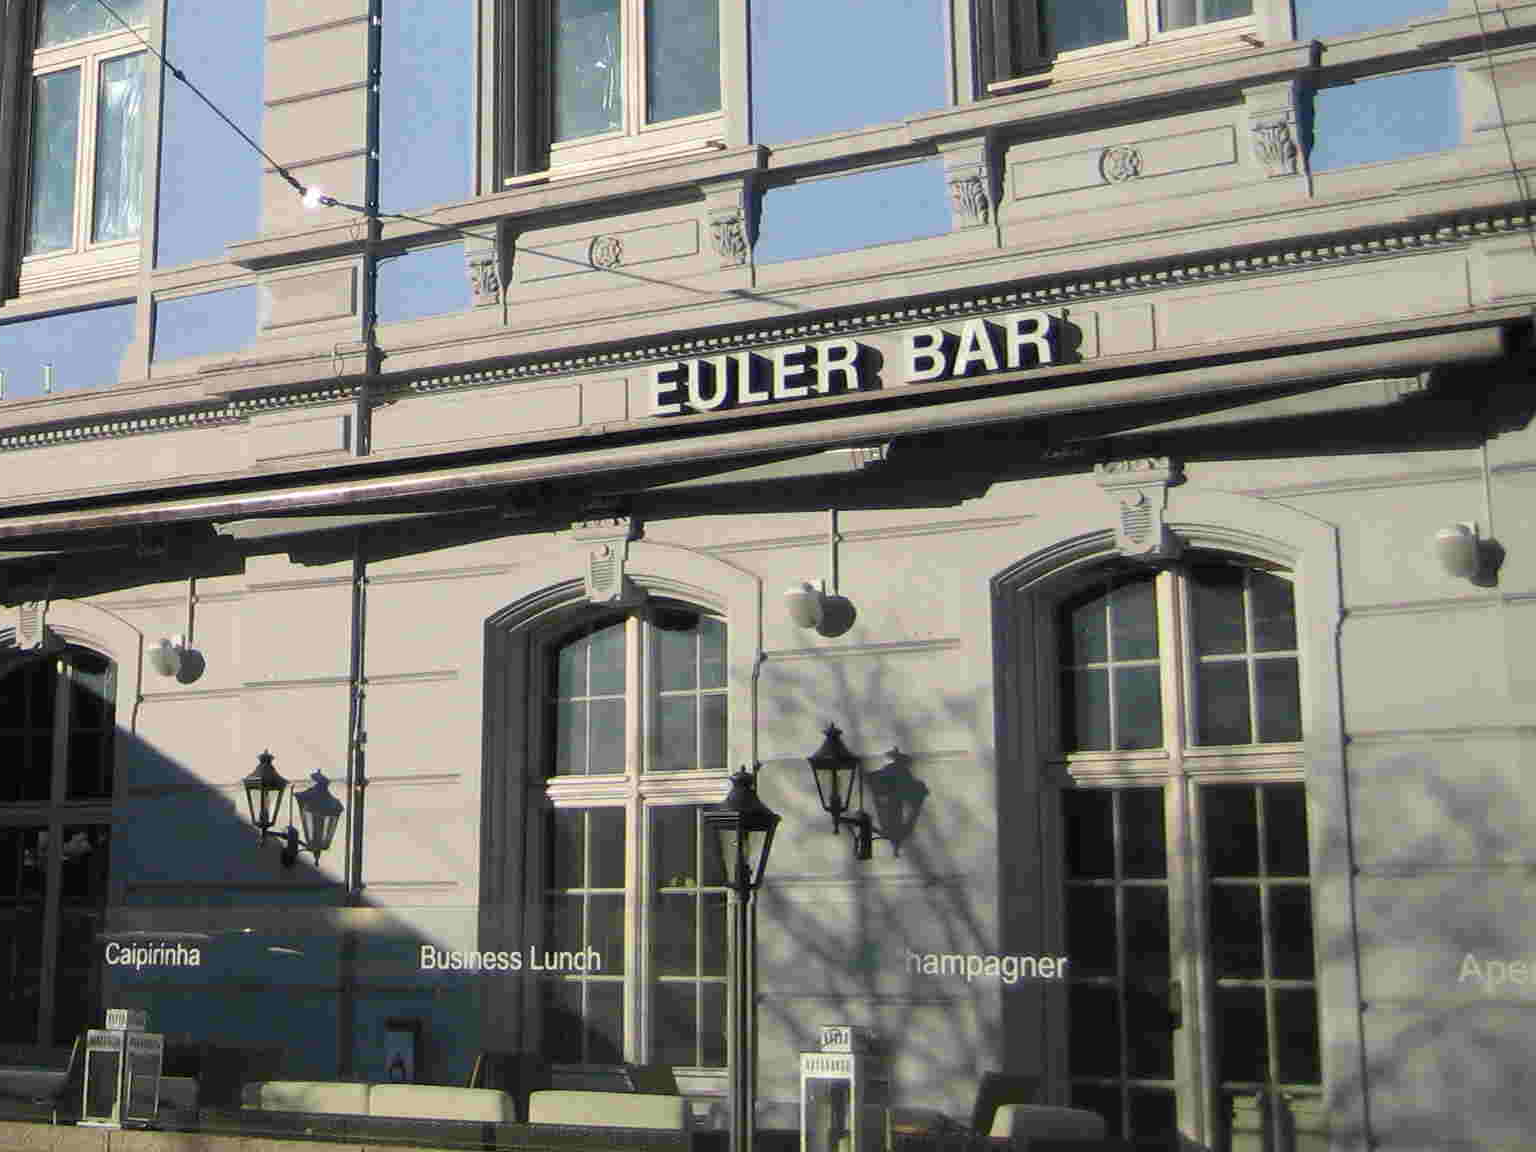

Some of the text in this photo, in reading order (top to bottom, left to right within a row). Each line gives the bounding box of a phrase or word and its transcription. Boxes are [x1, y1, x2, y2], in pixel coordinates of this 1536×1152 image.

[648, 309, 1060, 415] EULER BAR
[104, 940, 202, 970] Caipirinha
[419, 943, 602, 972] Business Lunch
[905, 948, 1069, 984] hampagner
